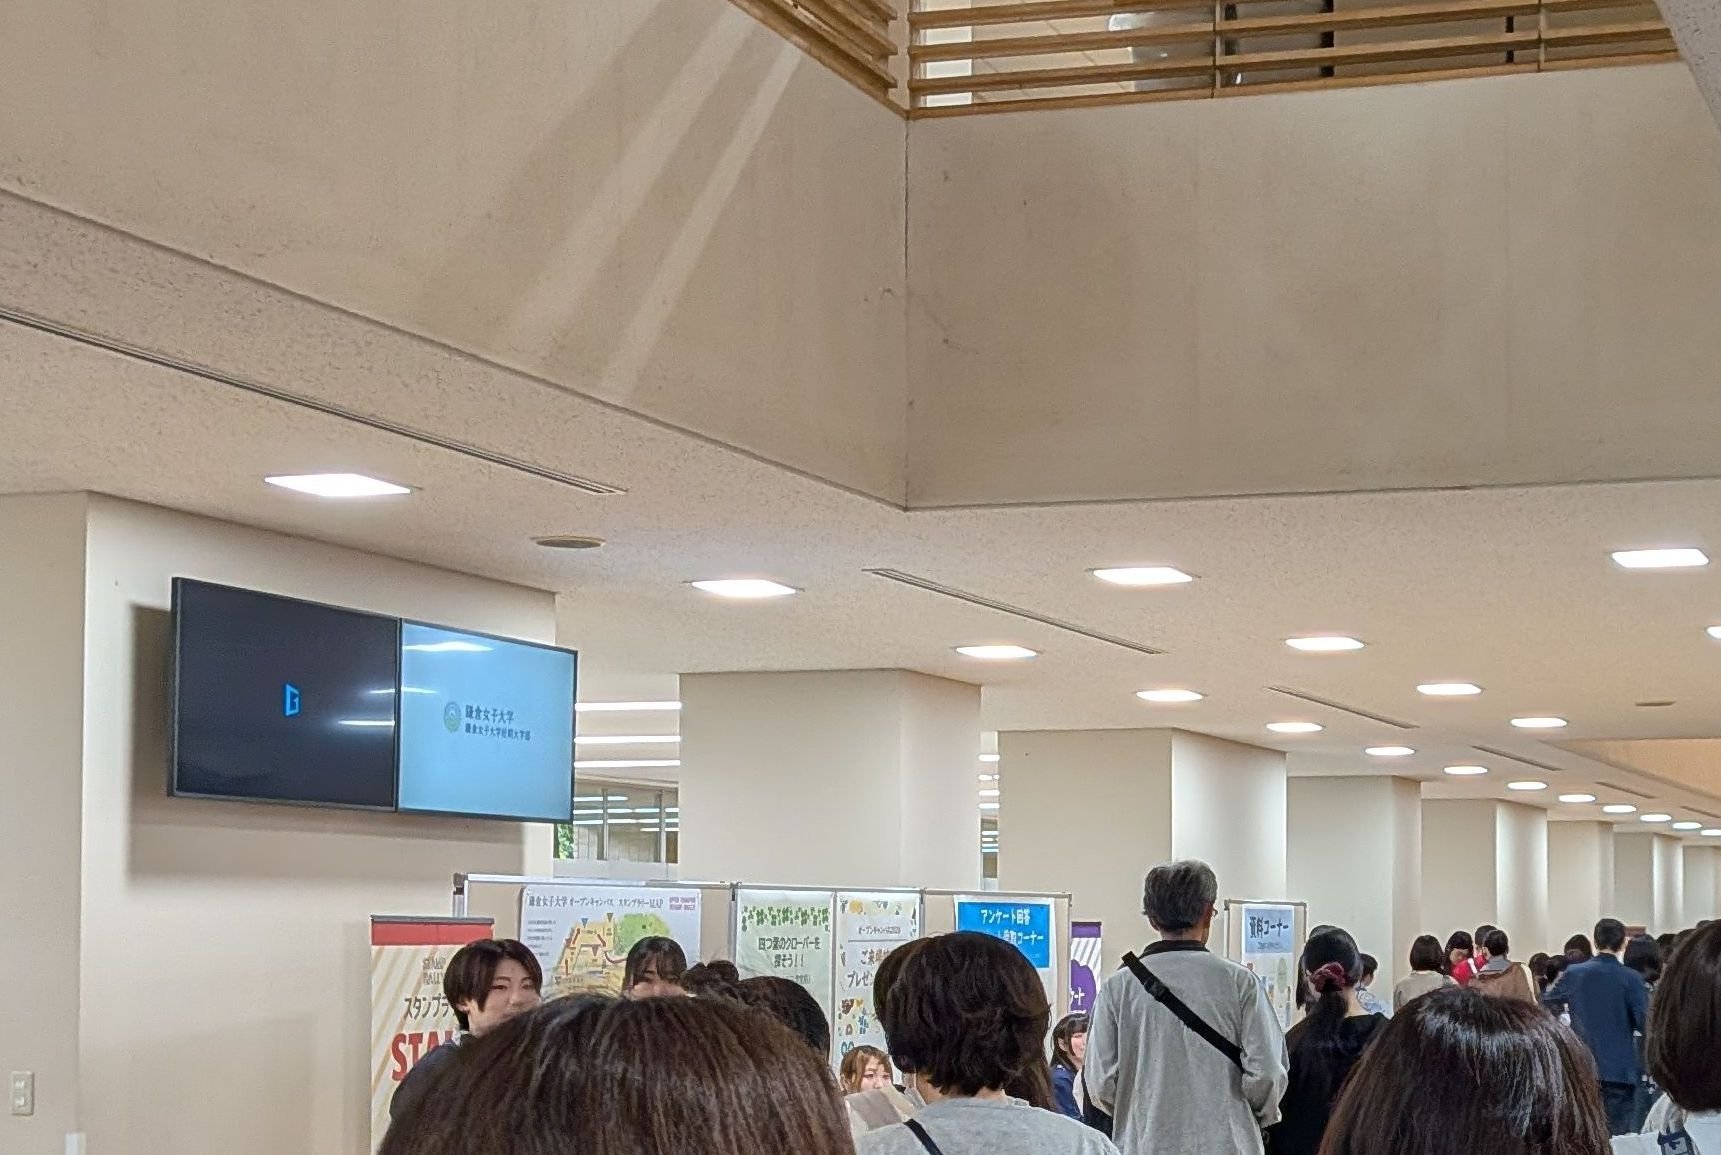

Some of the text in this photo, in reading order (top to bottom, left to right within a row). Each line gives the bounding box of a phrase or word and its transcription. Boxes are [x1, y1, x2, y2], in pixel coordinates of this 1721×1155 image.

[980, 908, 1031, 926] アンケート回答
[1249, 916, 1289, 939] 資料コーナー
[758, 936, 821, 951] 四つ葉のクローバーを
